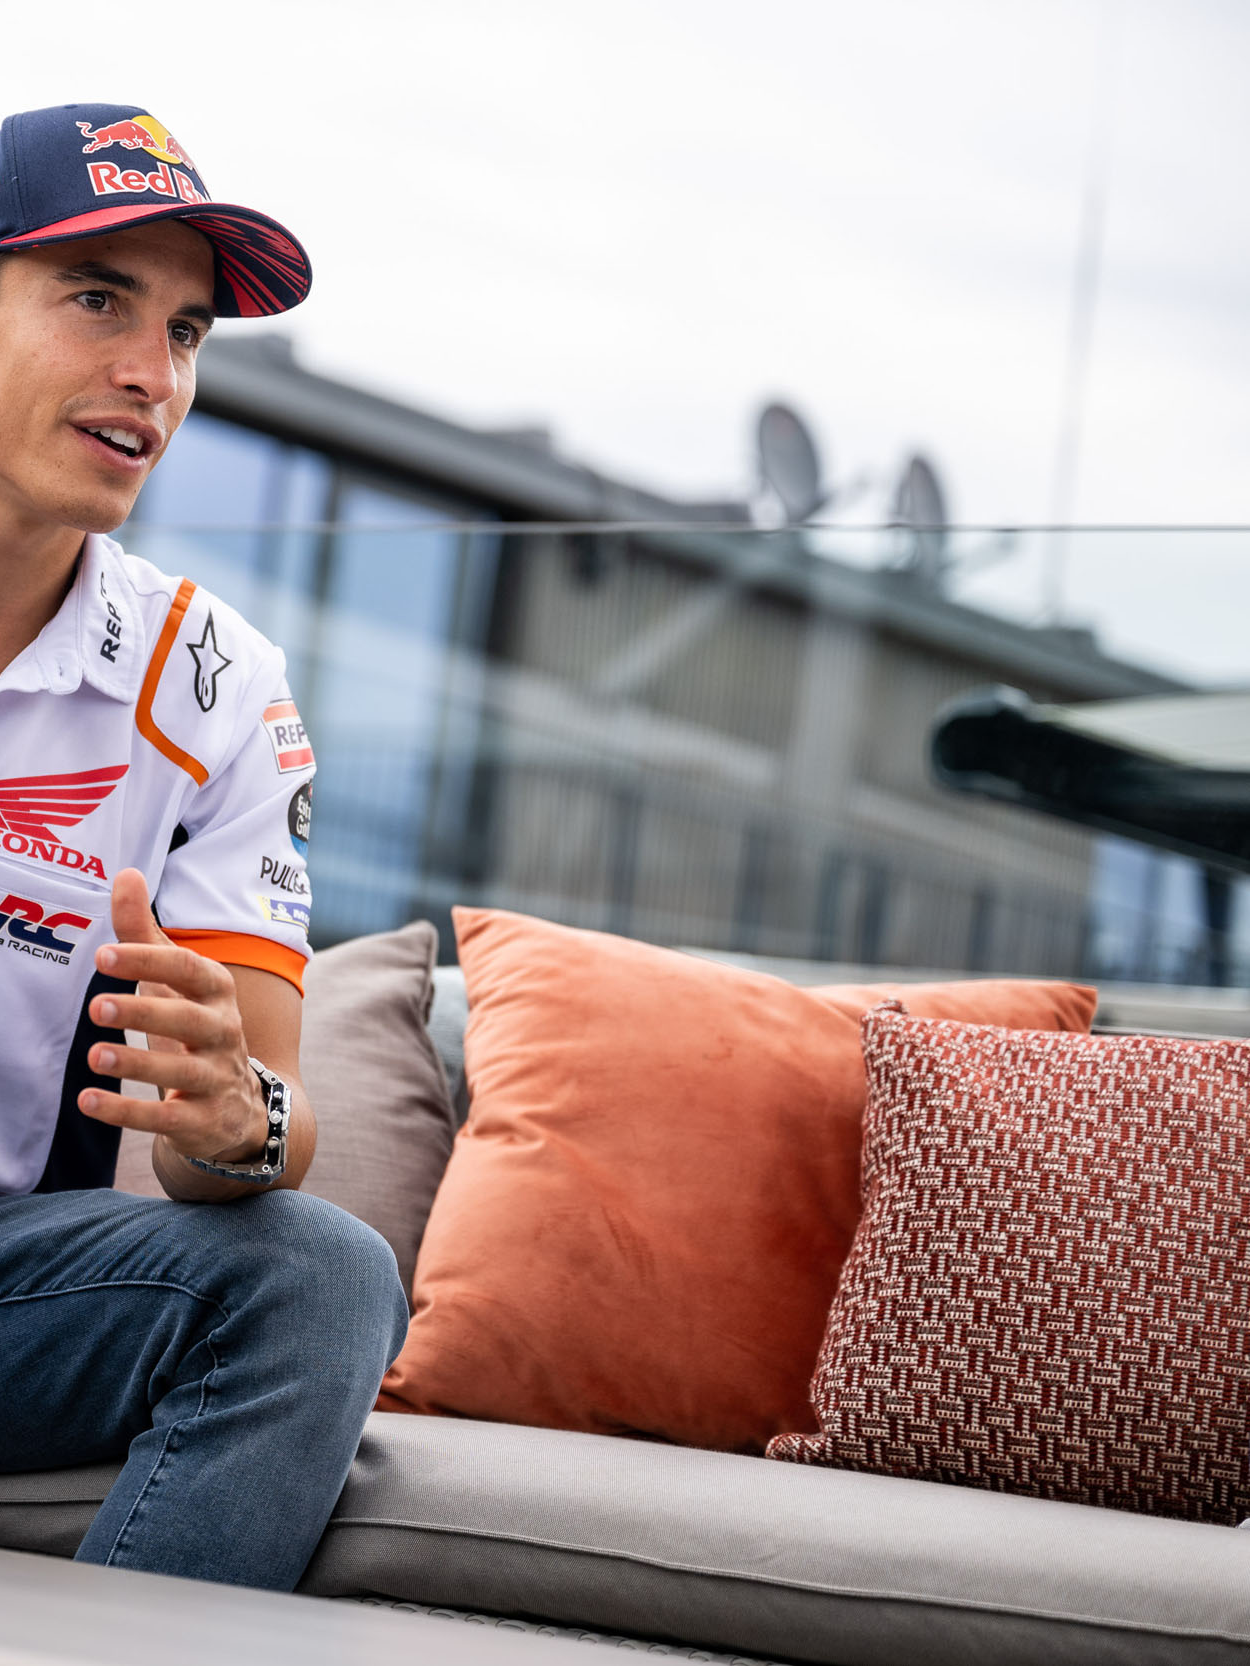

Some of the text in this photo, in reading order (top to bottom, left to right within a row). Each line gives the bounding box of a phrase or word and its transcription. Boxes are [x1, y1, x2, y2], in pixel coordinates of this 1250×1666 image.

[87, 161, 177, 197] Red
[274, 723, 308, 746] REP
[7, 939, 70, 966] RACING
